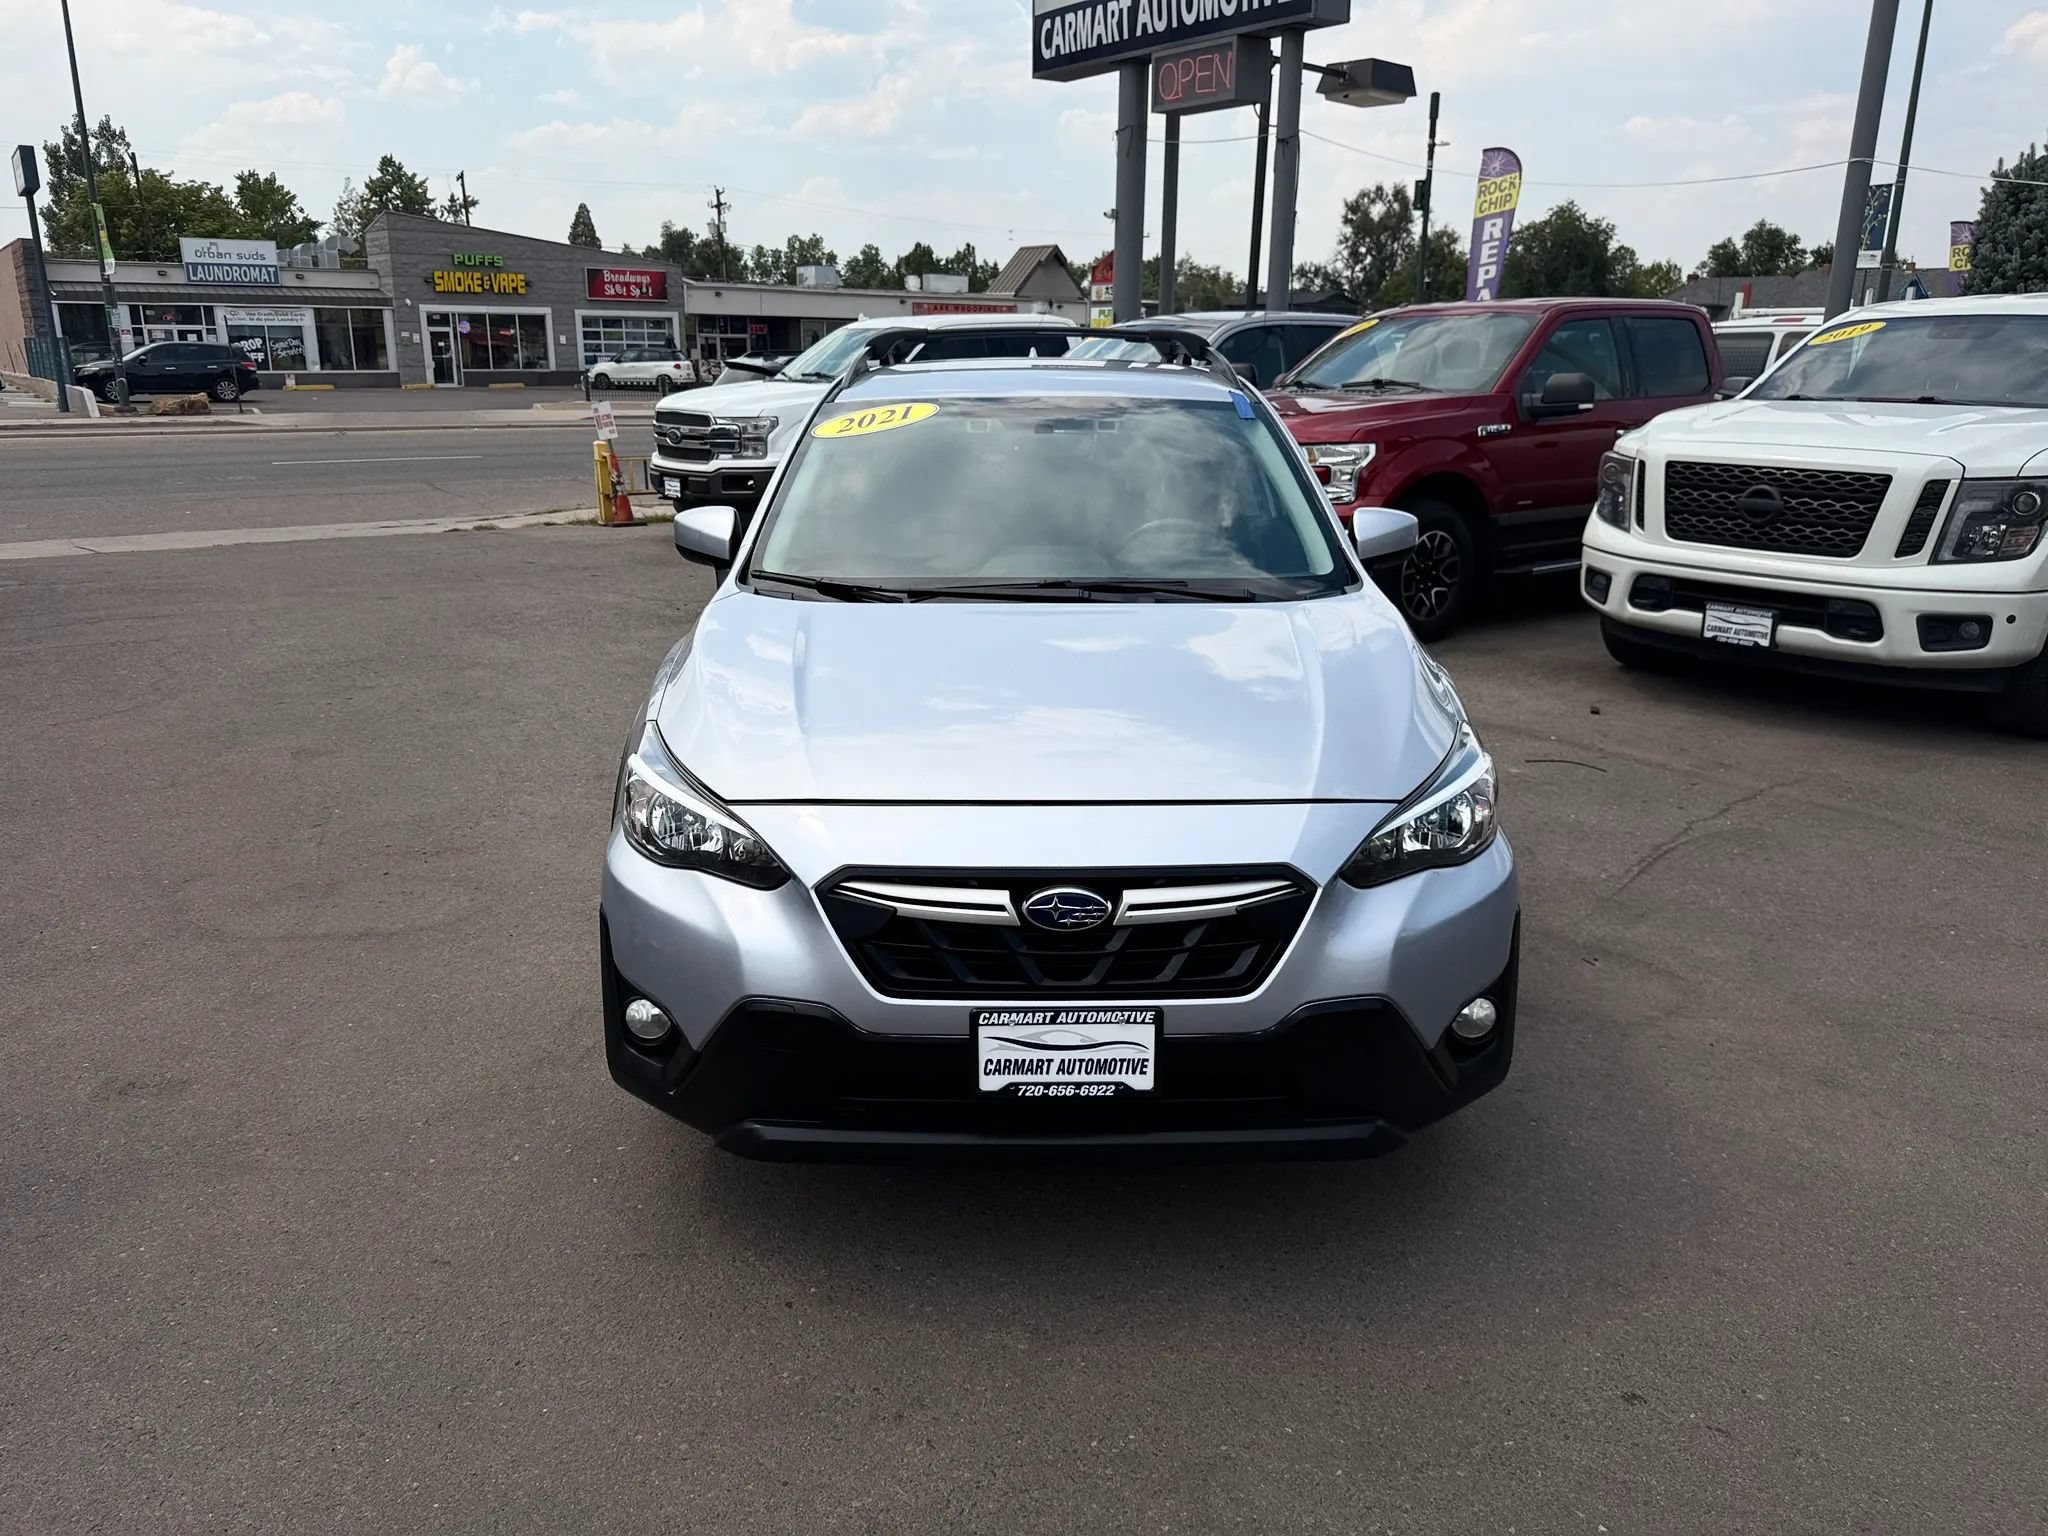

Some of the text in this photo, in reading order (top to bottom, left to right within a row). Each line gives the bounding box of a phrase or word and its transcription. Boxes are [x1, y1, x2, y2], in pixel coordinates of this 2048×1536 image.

[1040, 0, 1132, 60] CARMART
[1159, 51, 1233, 100] OPEN
[1478, 175, 1518, 199] ROCK
[1478, 193, 1513, 214] CHIP
[236, 251, 266, 261] suds
[453, 253, 504, 267] PUFFS
[1476, 217, 1504, 301] REPA
[188, 264, 275, 282] LAUNDROMAT
[602, 270, 651, 284] Broadways
[433, 271, 526, 295] SMOKE & VAPE
[836, 405, 913, 434] 2021
[1706, 624, 1733, 635] CARMART
[978, 1011, 1156, 1025] CARMART AUTOMOTIVE
[983, 1058, 1150, 1076] CARMART AUTOMOTIVE
[1017, 1085, 1116, 1097] 720-656-6922
